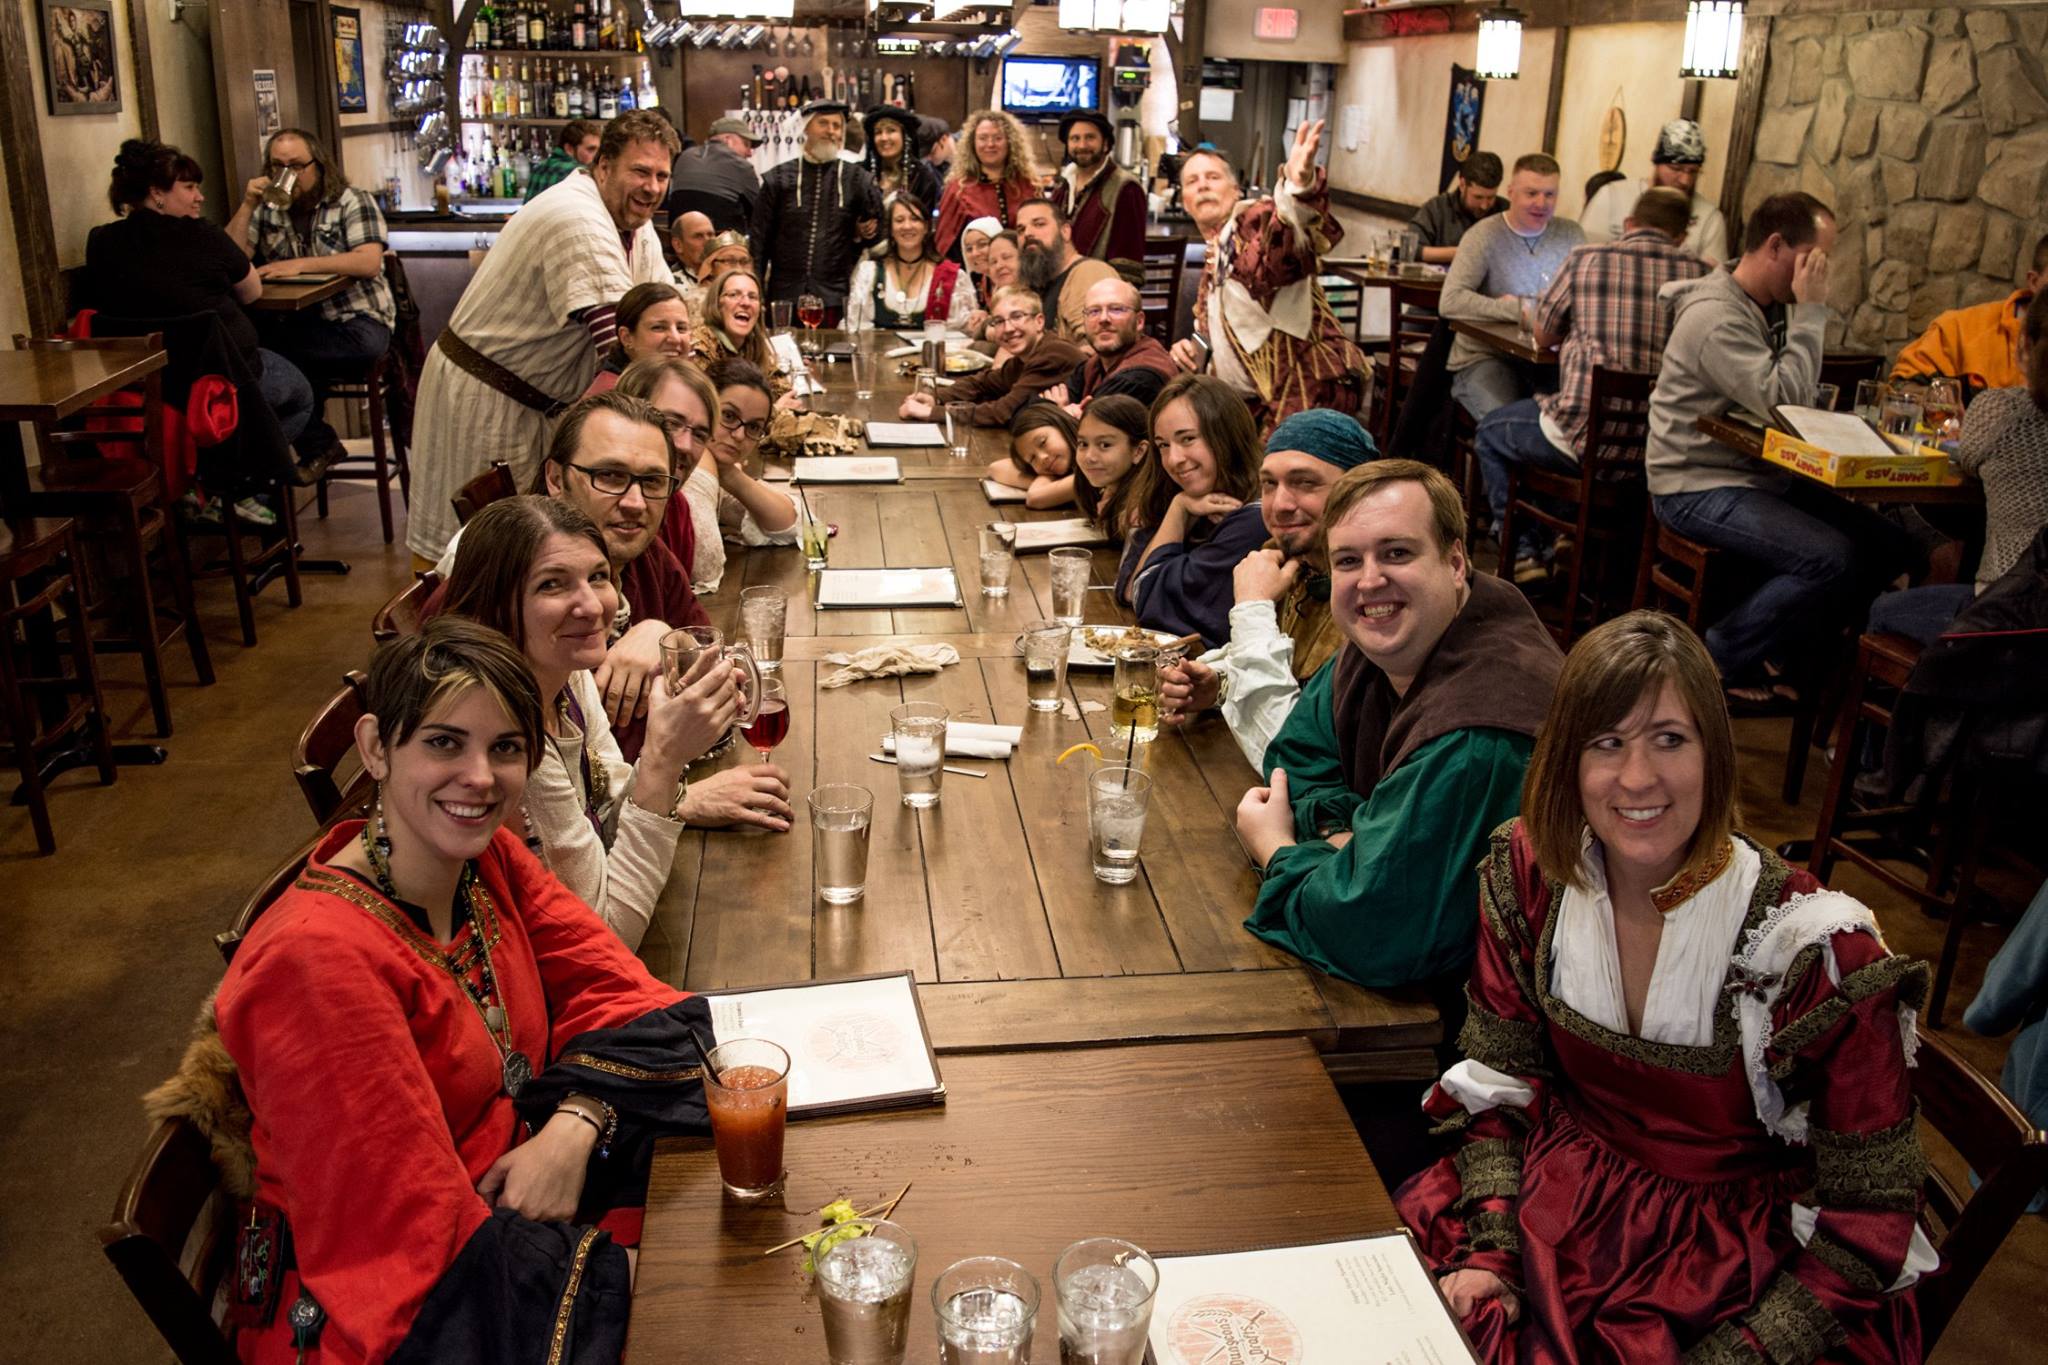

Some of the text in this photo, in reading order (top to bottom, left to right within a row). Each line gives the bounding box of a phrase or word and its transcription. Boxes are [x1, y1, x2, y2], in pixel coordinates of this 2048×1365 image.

[1780, 449, 1798, 461] ASS
[1796, 461, 1823, 477] SMART
[1865, 468, 1929, 483] SMART ASS
[1240, 1323, 1265, 1356] Drafts
